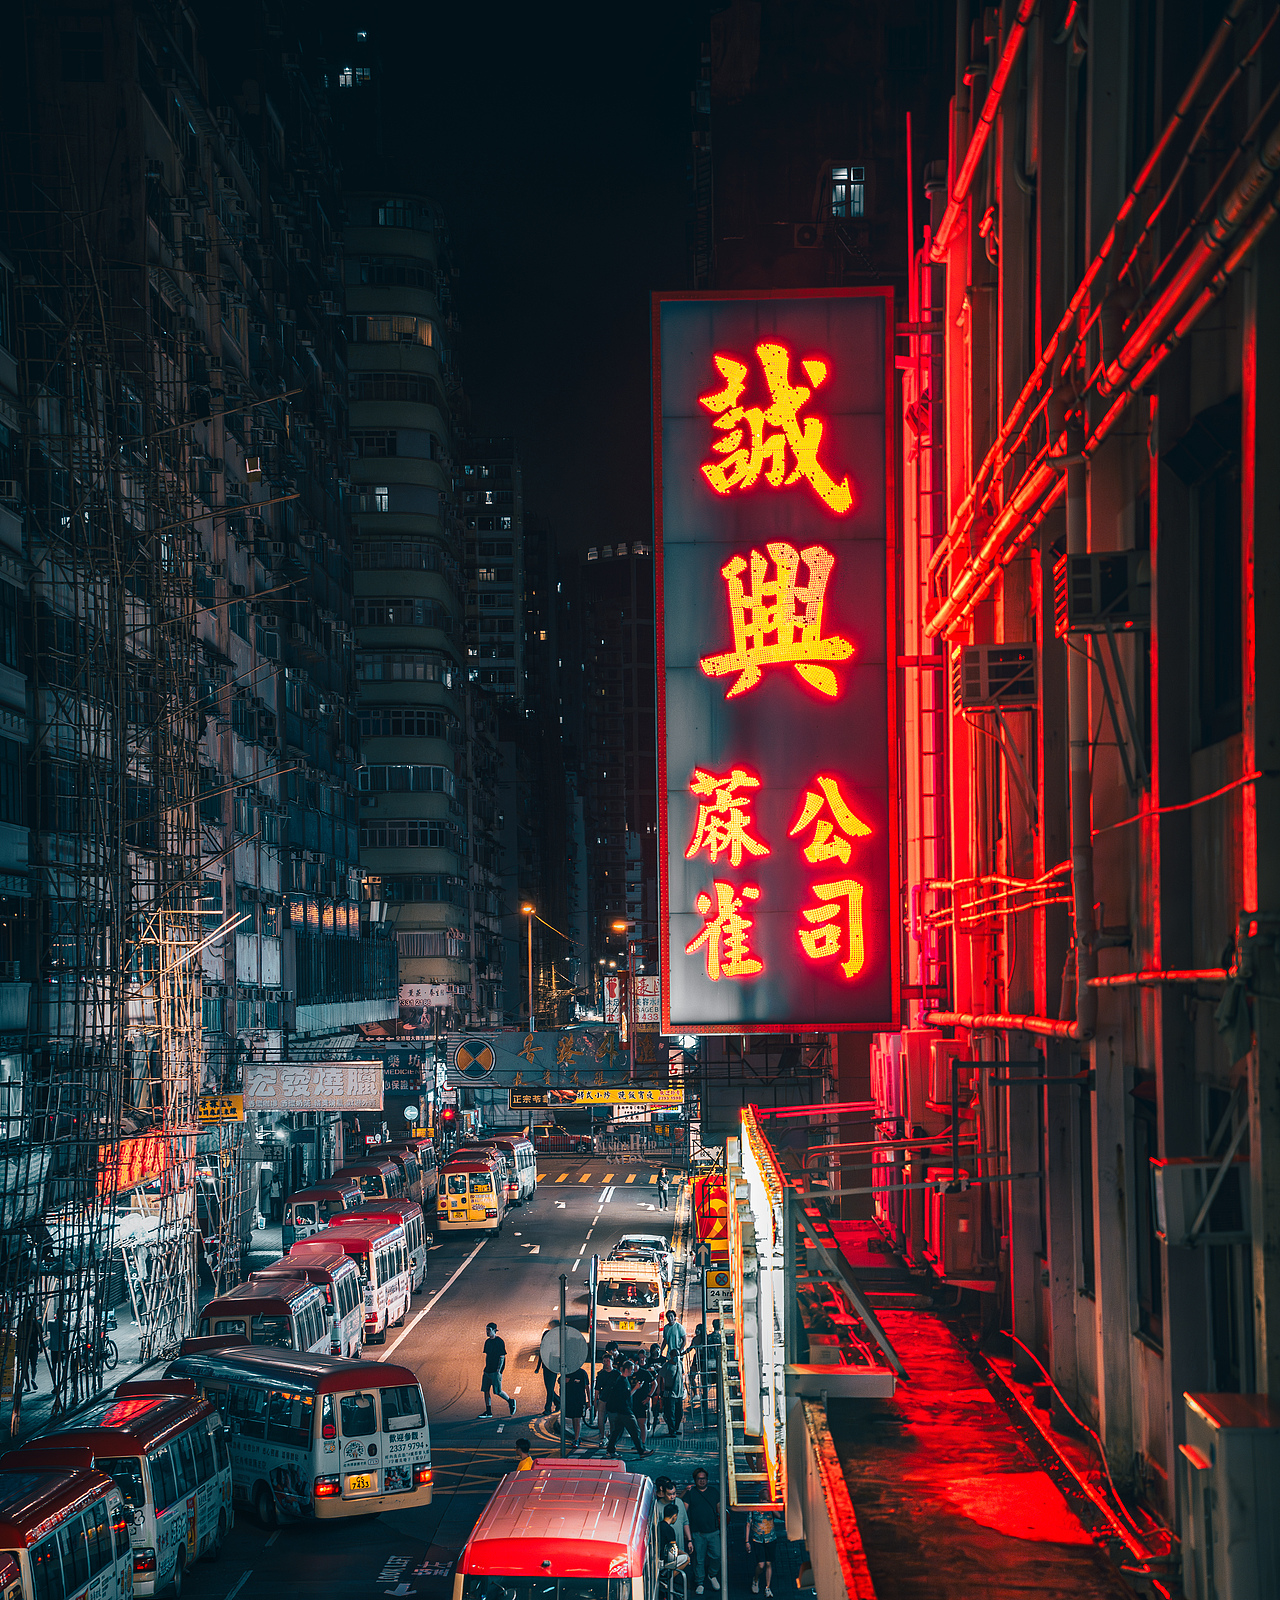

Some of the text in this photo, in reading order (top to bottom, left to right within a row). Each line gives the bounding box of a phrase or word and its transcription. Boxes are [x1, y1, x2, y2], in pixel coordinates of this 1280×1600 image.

[698, 342, 854, 698] 誠興
[788, 775, 872, 979] 公司
[389, 1442, 424, 1452] 2337 9794
